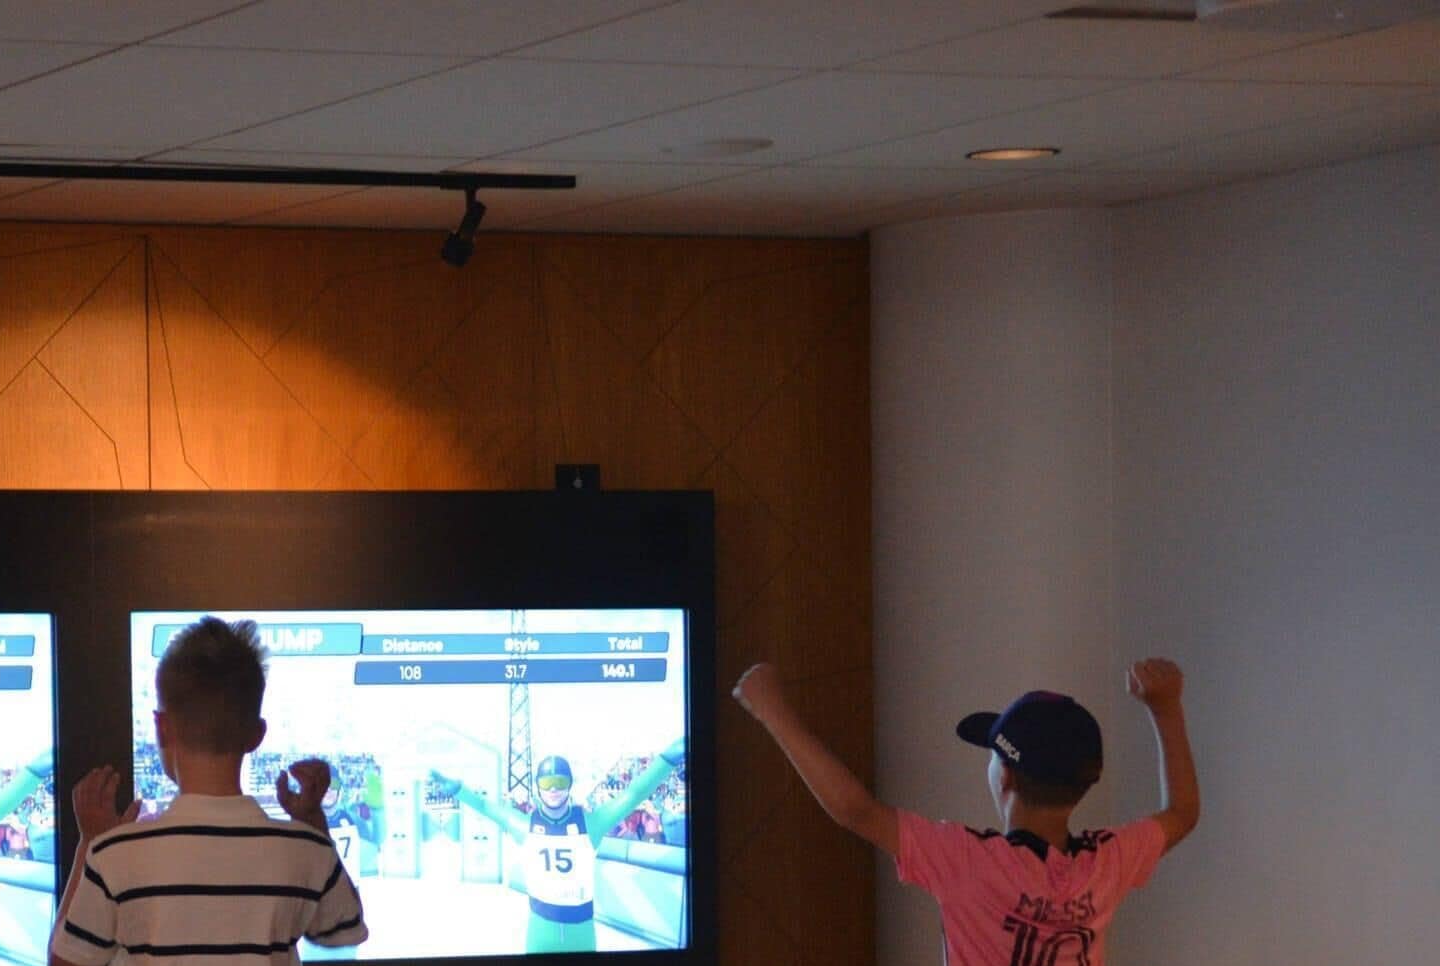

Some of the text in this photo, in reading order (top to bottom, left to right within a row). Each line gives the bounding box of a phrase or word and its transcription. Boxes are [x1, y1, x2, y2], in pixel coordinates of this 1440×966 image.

[382, 635, 643, 654] Distance Style Total
[399, 664, 422, 681] 108
[504, 663, 528, 680] 31.7
[539, 847, 573, 873] 15
